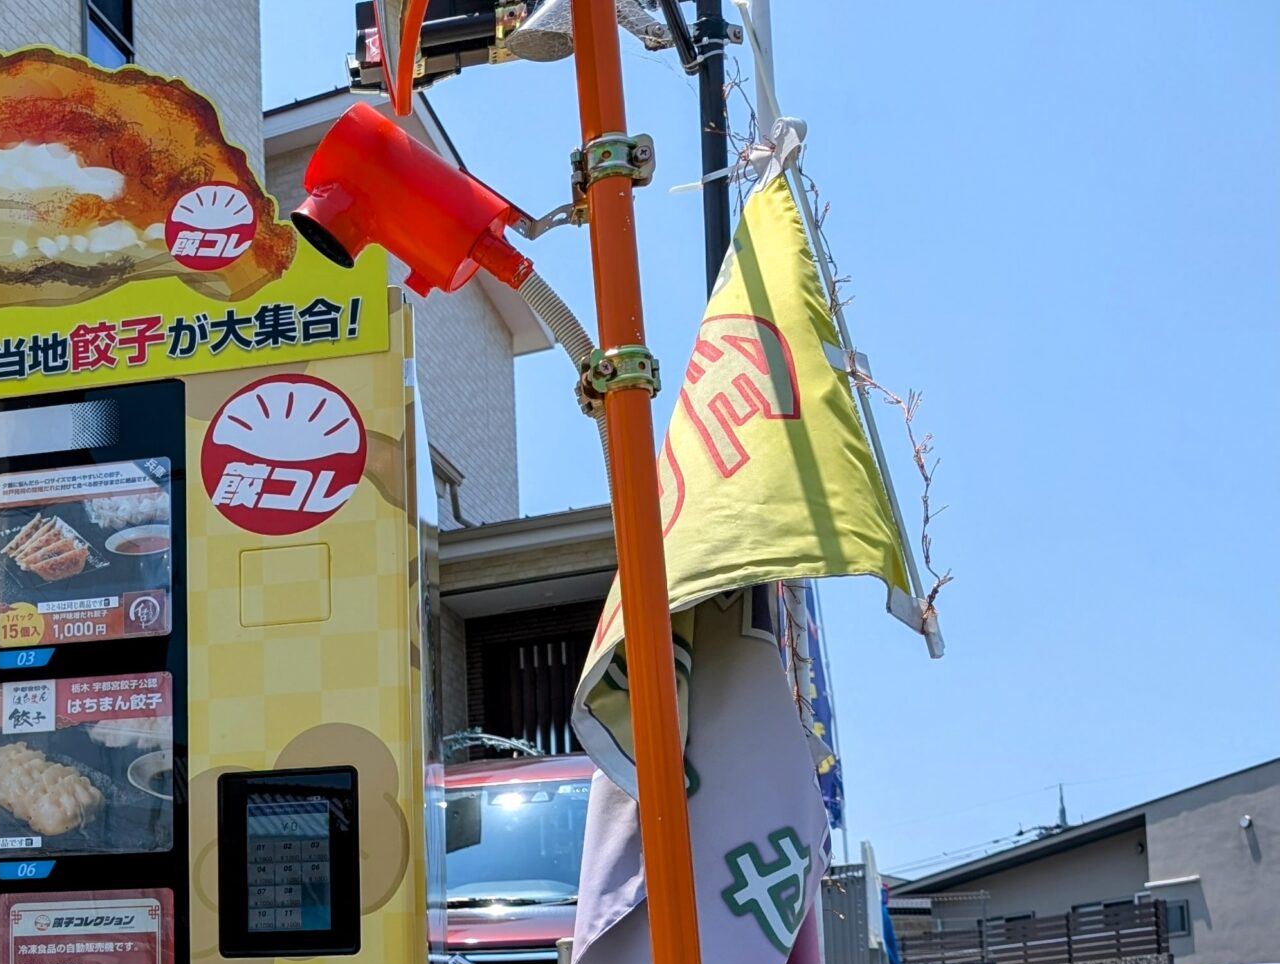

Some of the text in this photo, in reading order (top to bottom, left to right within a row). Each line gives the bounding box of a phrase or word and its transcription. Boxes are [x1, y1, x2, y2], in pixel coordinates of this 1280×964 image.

[171, 231, 253, 258] 餃コレ
[211, 461, 359, 513] 餃コレ
[6, 612, 34, 622] 1パック
[1, 623, 41, 639] 15個入
[52, 622, 107, 638] 1,000円
[16, 651, 36, 666] 03
[93, 678, 158, 692] 宇都宮餃子公認
[67, 692, 163, 714] はちまん餃子
[8, 707, 47, 729] 餃子
[17, 863, 36, 877] 06
[51, 915, 136, 929] 餃子コレクション
[18, 941, 138, 955] 冷凍食品の自動販売機です。
